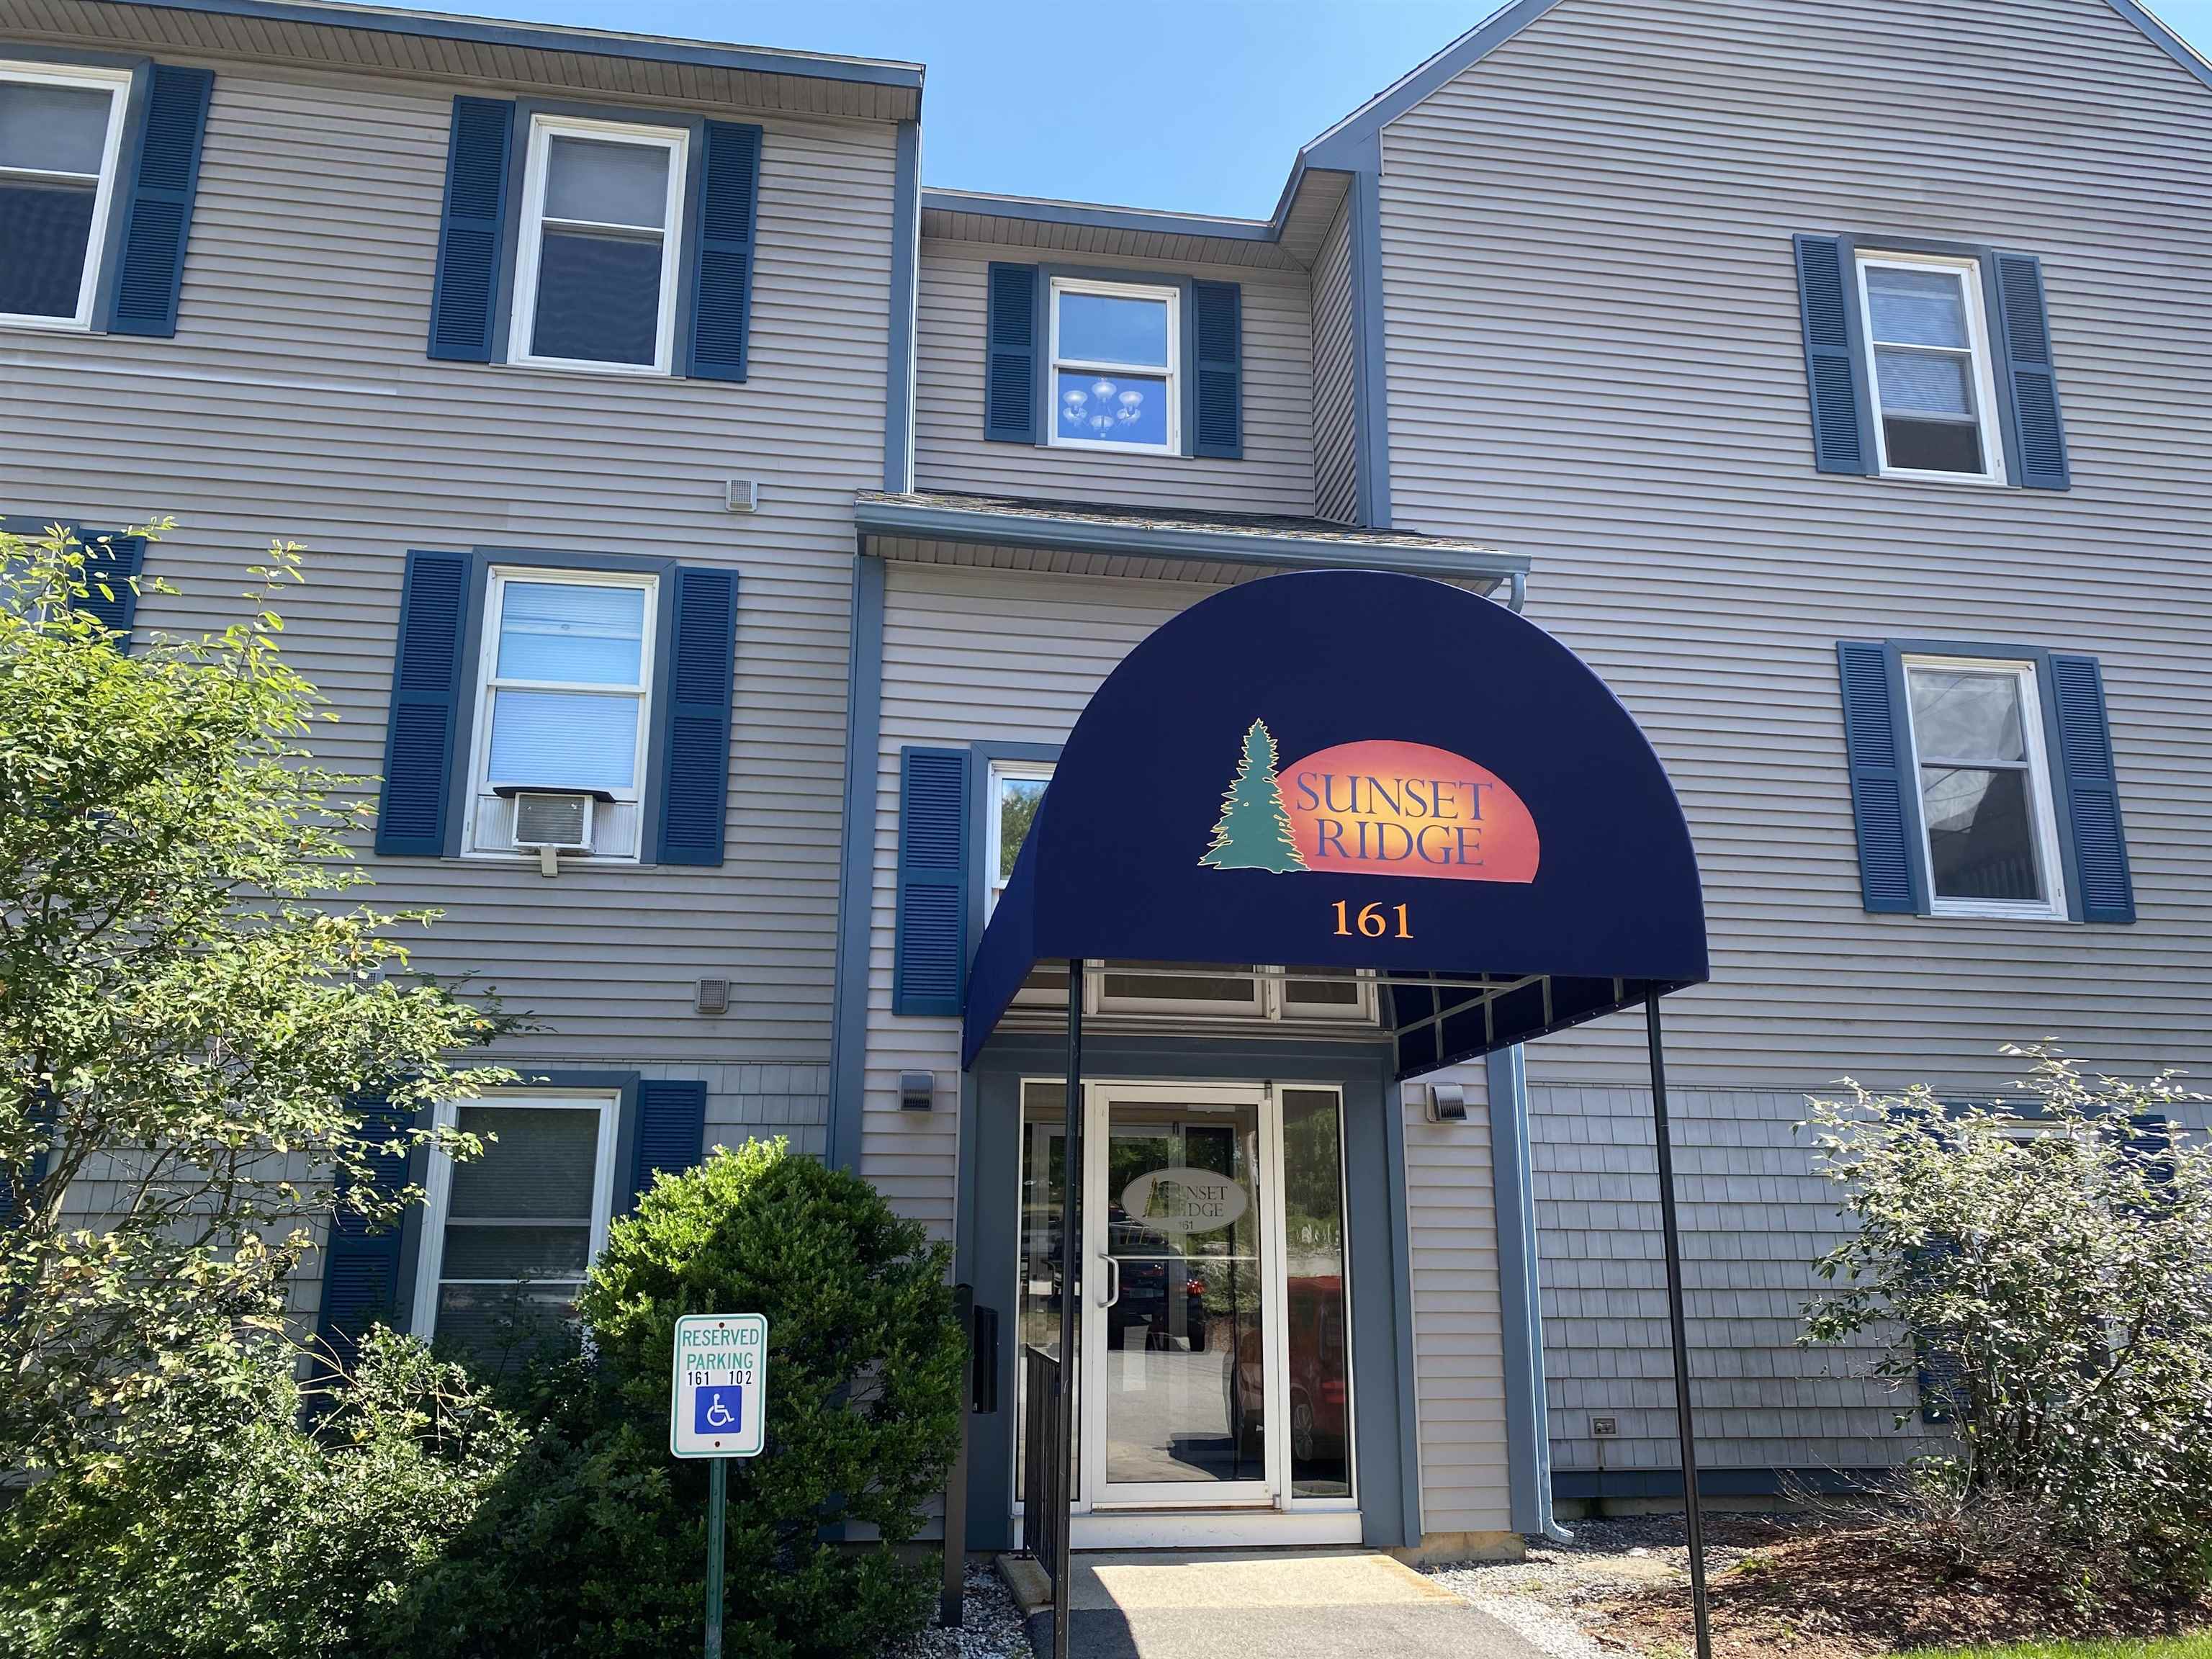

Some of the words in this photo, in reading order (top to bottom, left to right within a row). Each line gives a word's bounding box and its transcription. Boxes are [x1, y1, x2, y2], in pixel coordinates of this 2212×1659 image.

[1297, 772, 1493, 821] SUNSET
[1314, 818, 1484, 865] RIDGE
[1331, 899, 1414, 939] 161
[1164, 1185, 1228, 1200] NSET
[683, 1328, 759, 1346] RESERVED
[687, 1352, 753, 1370] PARKING
[688, 1371, 709, 1386] 161
[729, 1370, 752, 1385] 102
